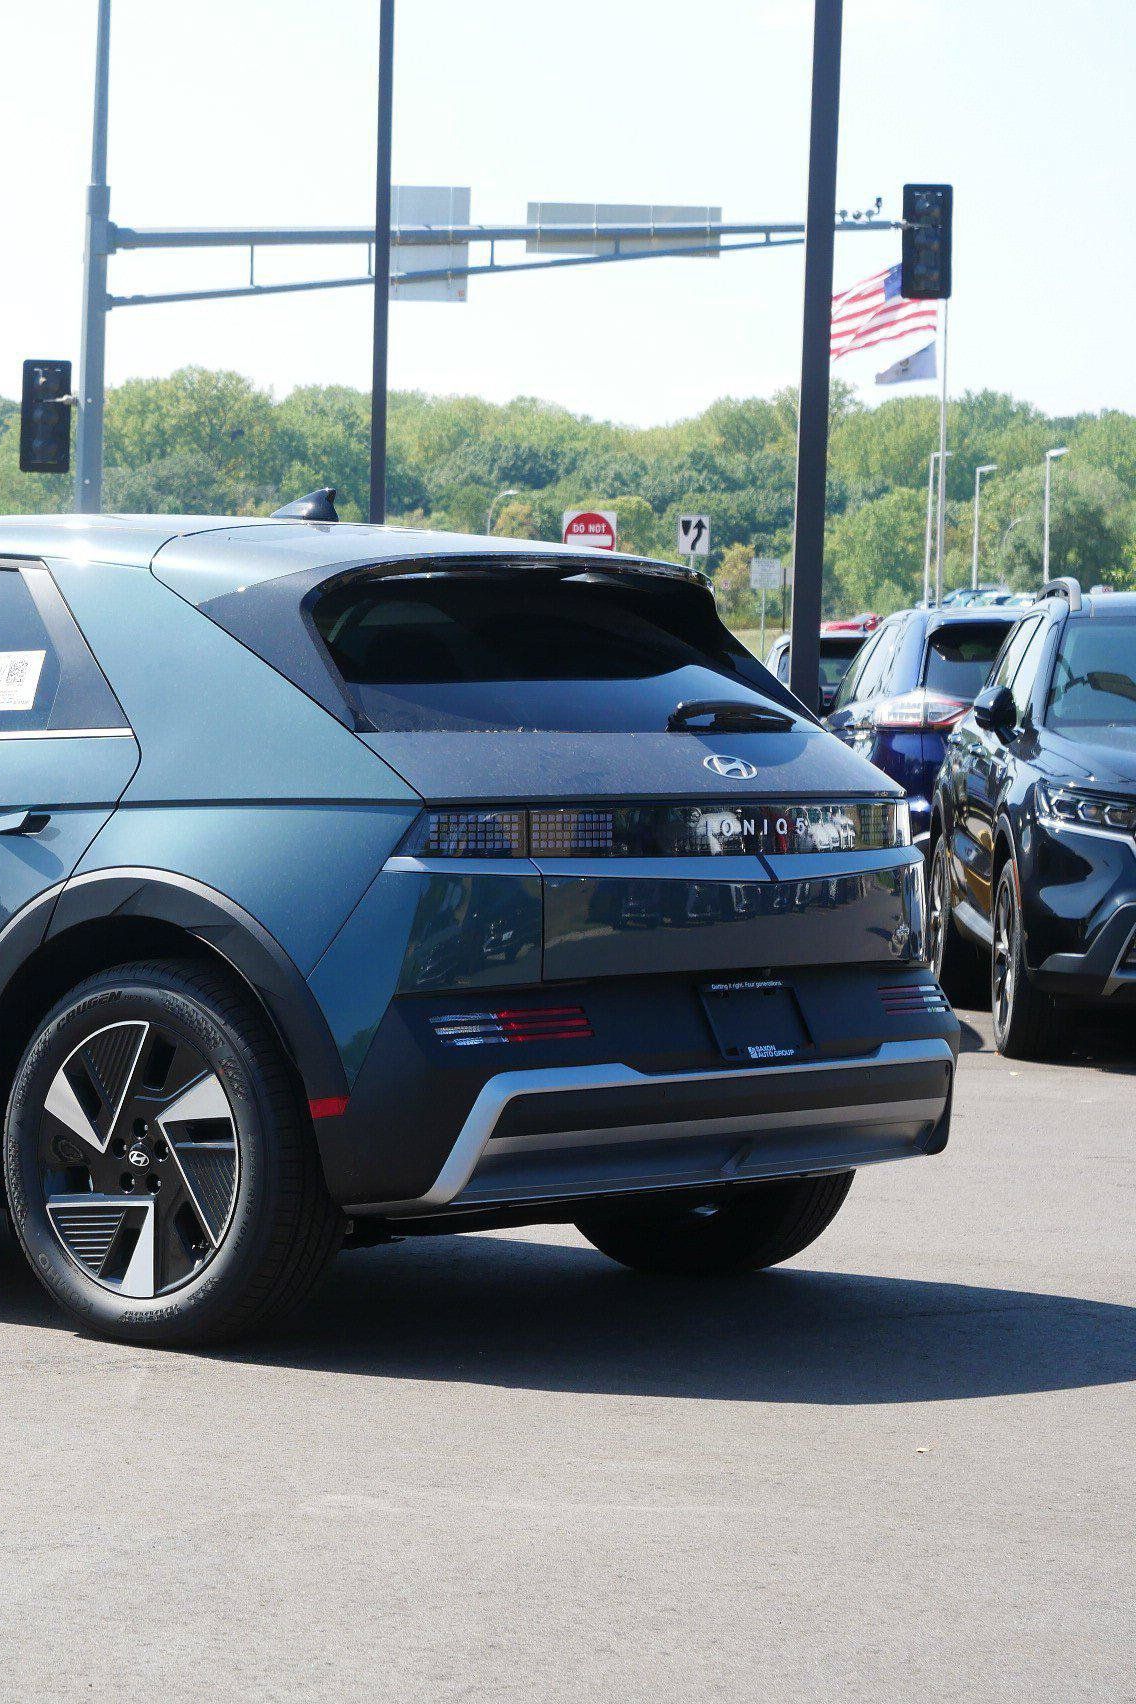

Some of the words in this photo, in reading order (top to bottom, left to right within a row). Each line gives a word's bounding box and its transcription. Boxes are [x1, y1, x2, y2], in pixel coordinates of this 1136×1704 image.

[573, 523, 585, 534] DO
[588, 523, 607, 534] NOT
[758, 1050, 774, 1058] AUTO
[774, 1049, 795, 1057] GROUP
